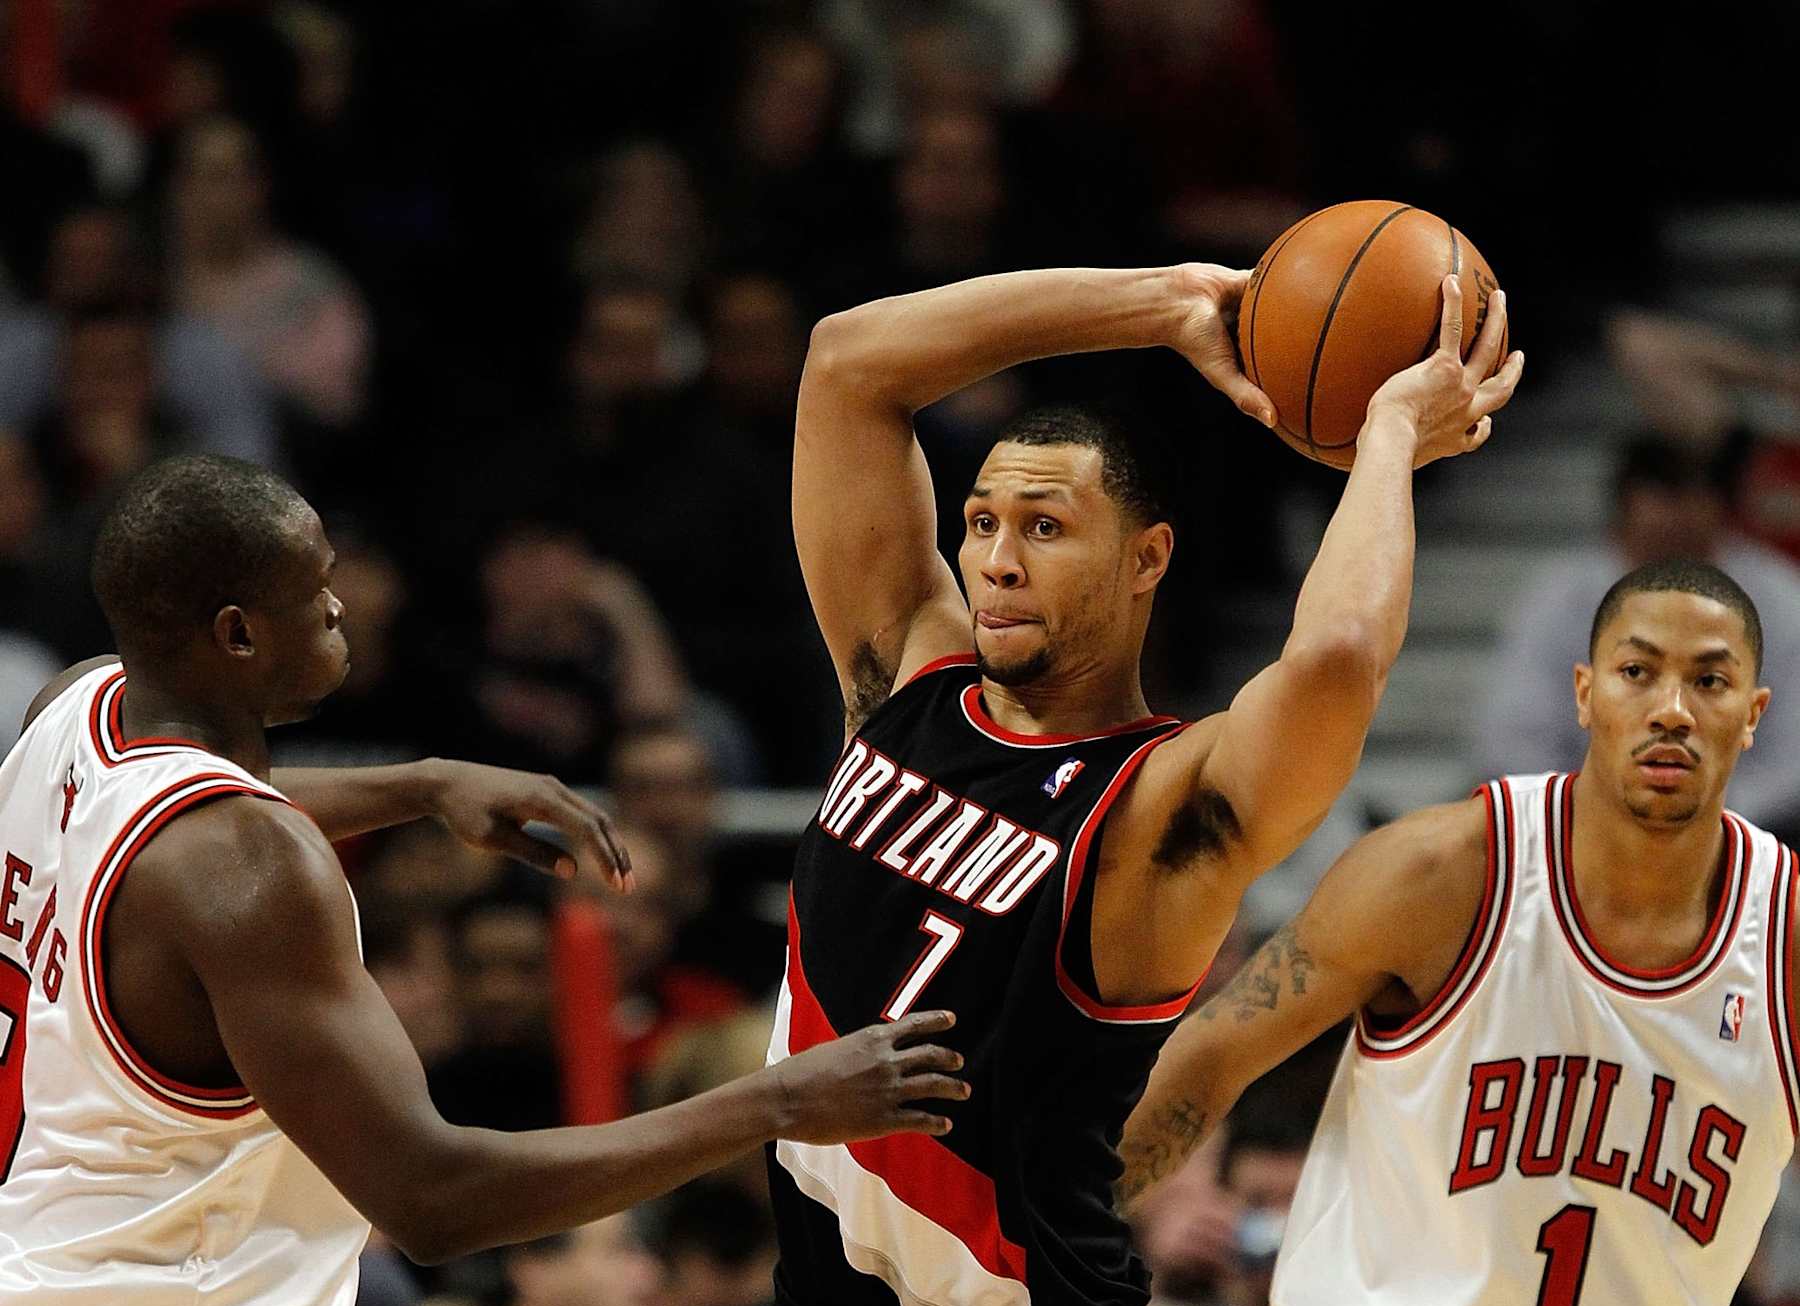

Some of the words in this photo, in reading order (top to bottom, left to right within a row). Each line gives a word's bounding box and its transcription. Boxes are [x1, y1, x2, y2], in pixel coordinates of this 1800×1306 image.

[818, 738, 1060, 915] ORTLAND
[879, 908, 965, 1022] 7
[1448, 1055, 1747, 1248] BULLS
